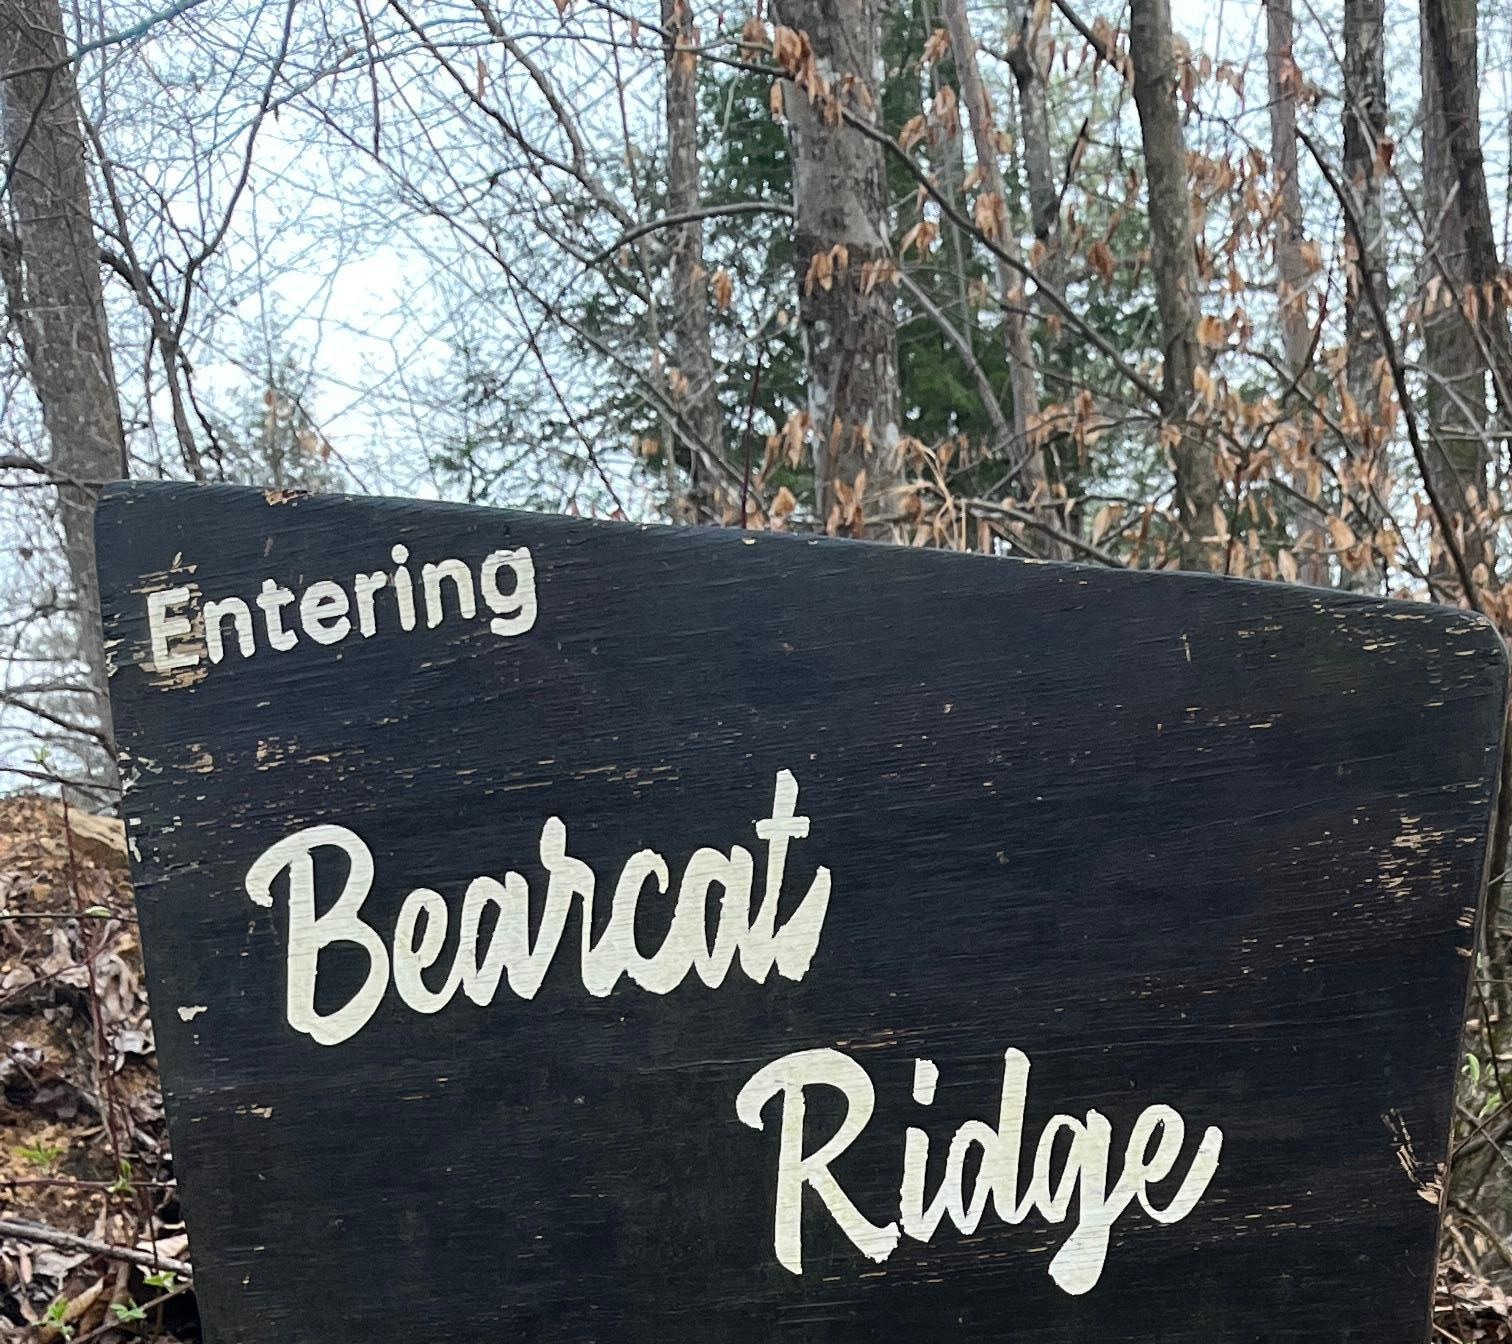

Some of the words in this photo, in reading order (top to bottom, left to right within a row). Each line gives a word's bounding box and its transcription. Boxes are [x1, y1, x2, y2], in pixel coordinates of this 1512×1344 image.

[147, 544, 538, 672] Entering
[245, 768, 832, 1046] Bearcat
[736, 1047, 1224, 1296] Ridge
